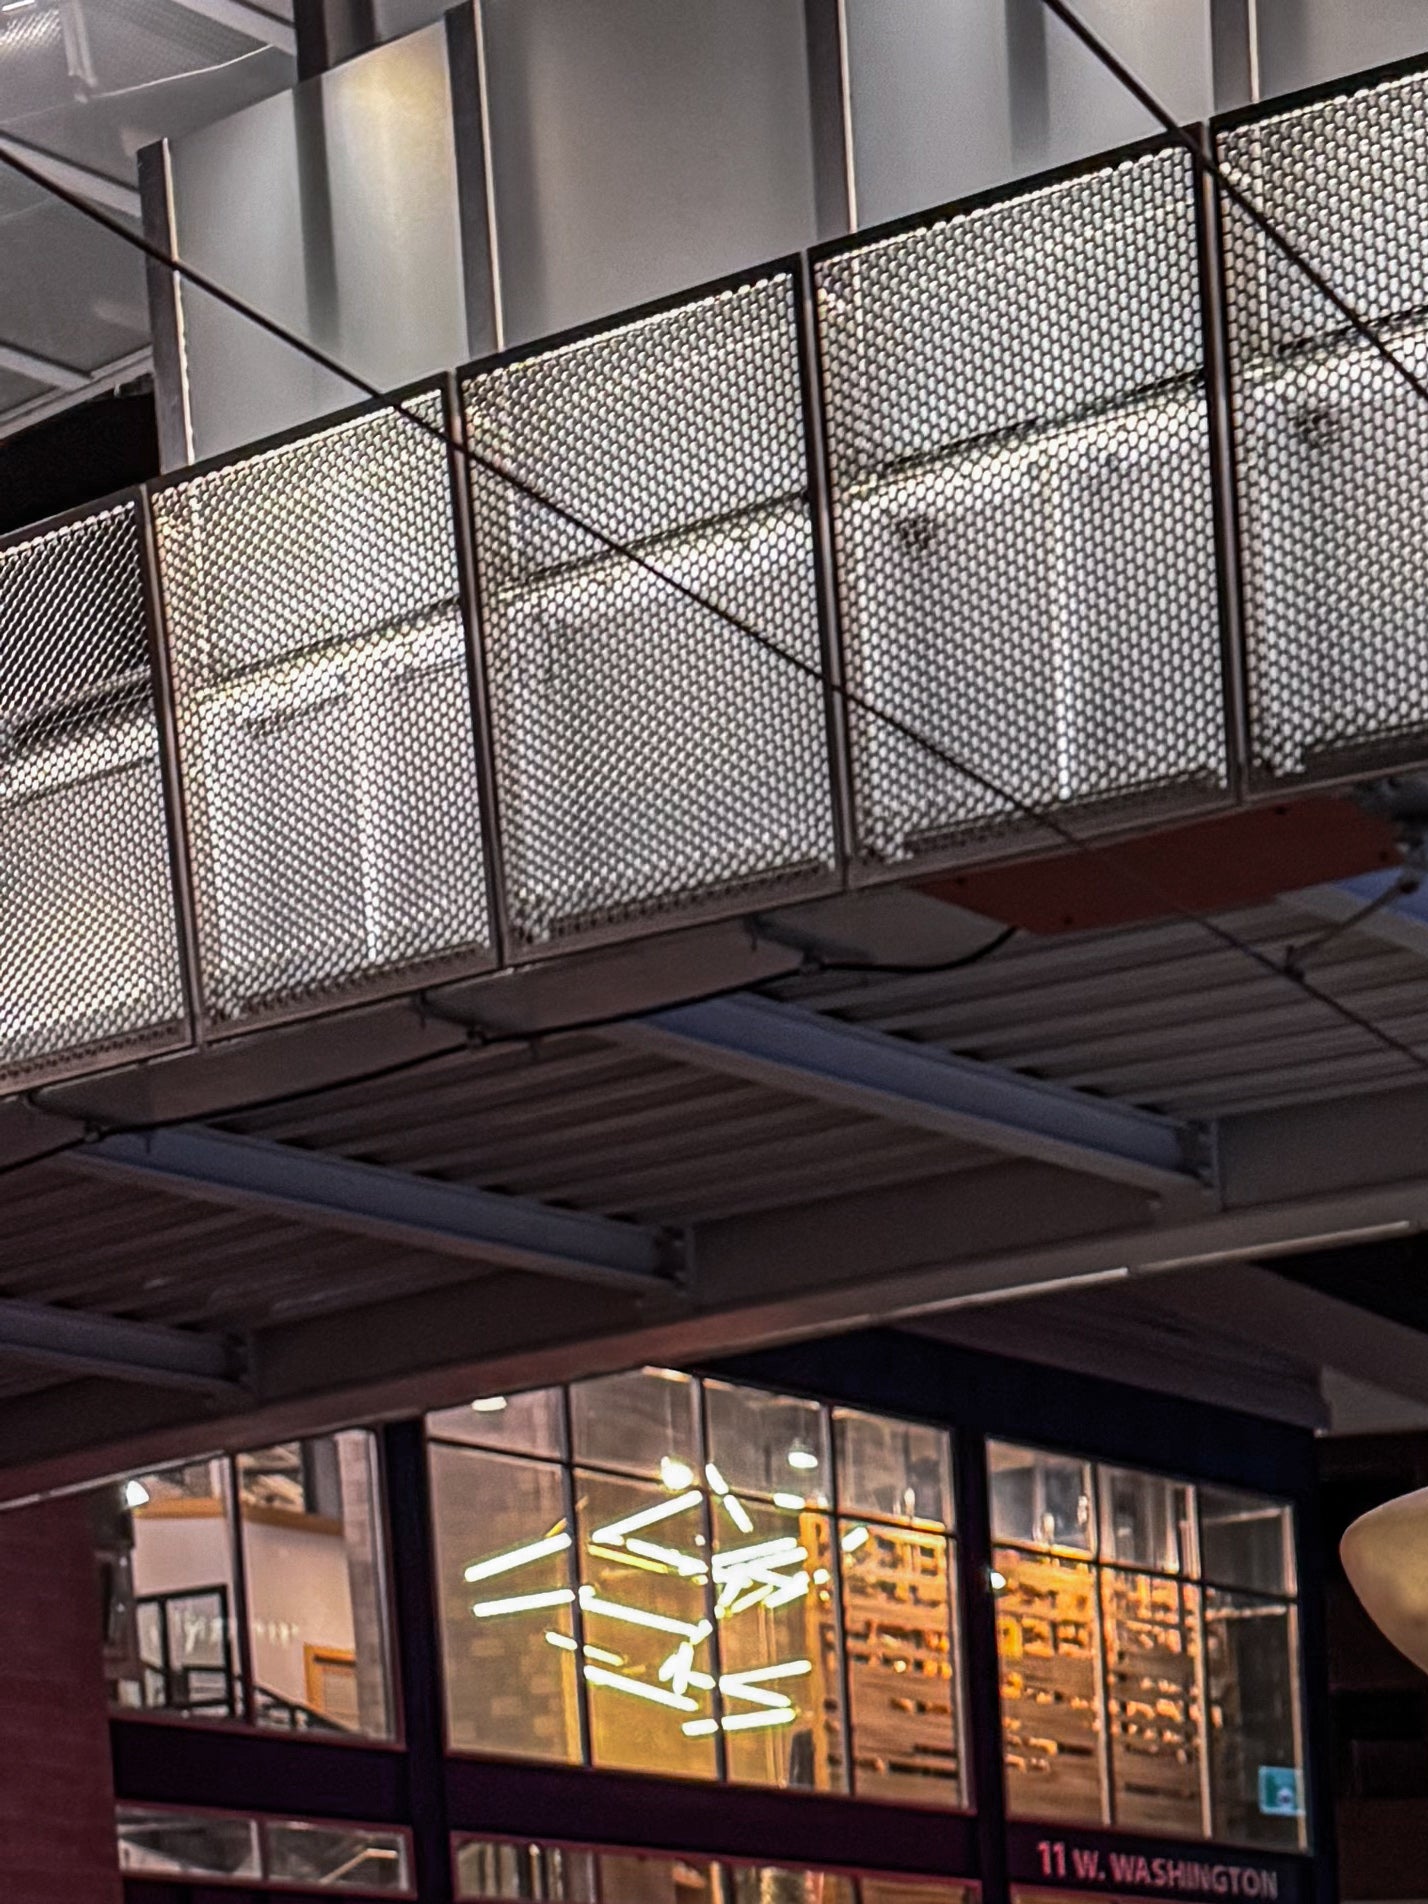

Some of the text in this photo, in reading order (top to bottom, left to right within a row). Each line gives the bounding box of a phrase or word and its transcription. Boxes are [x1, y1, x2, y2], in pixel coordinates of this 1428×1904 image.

[1038, 1840, 1278, 1900] 11 W. WASHINGTON
